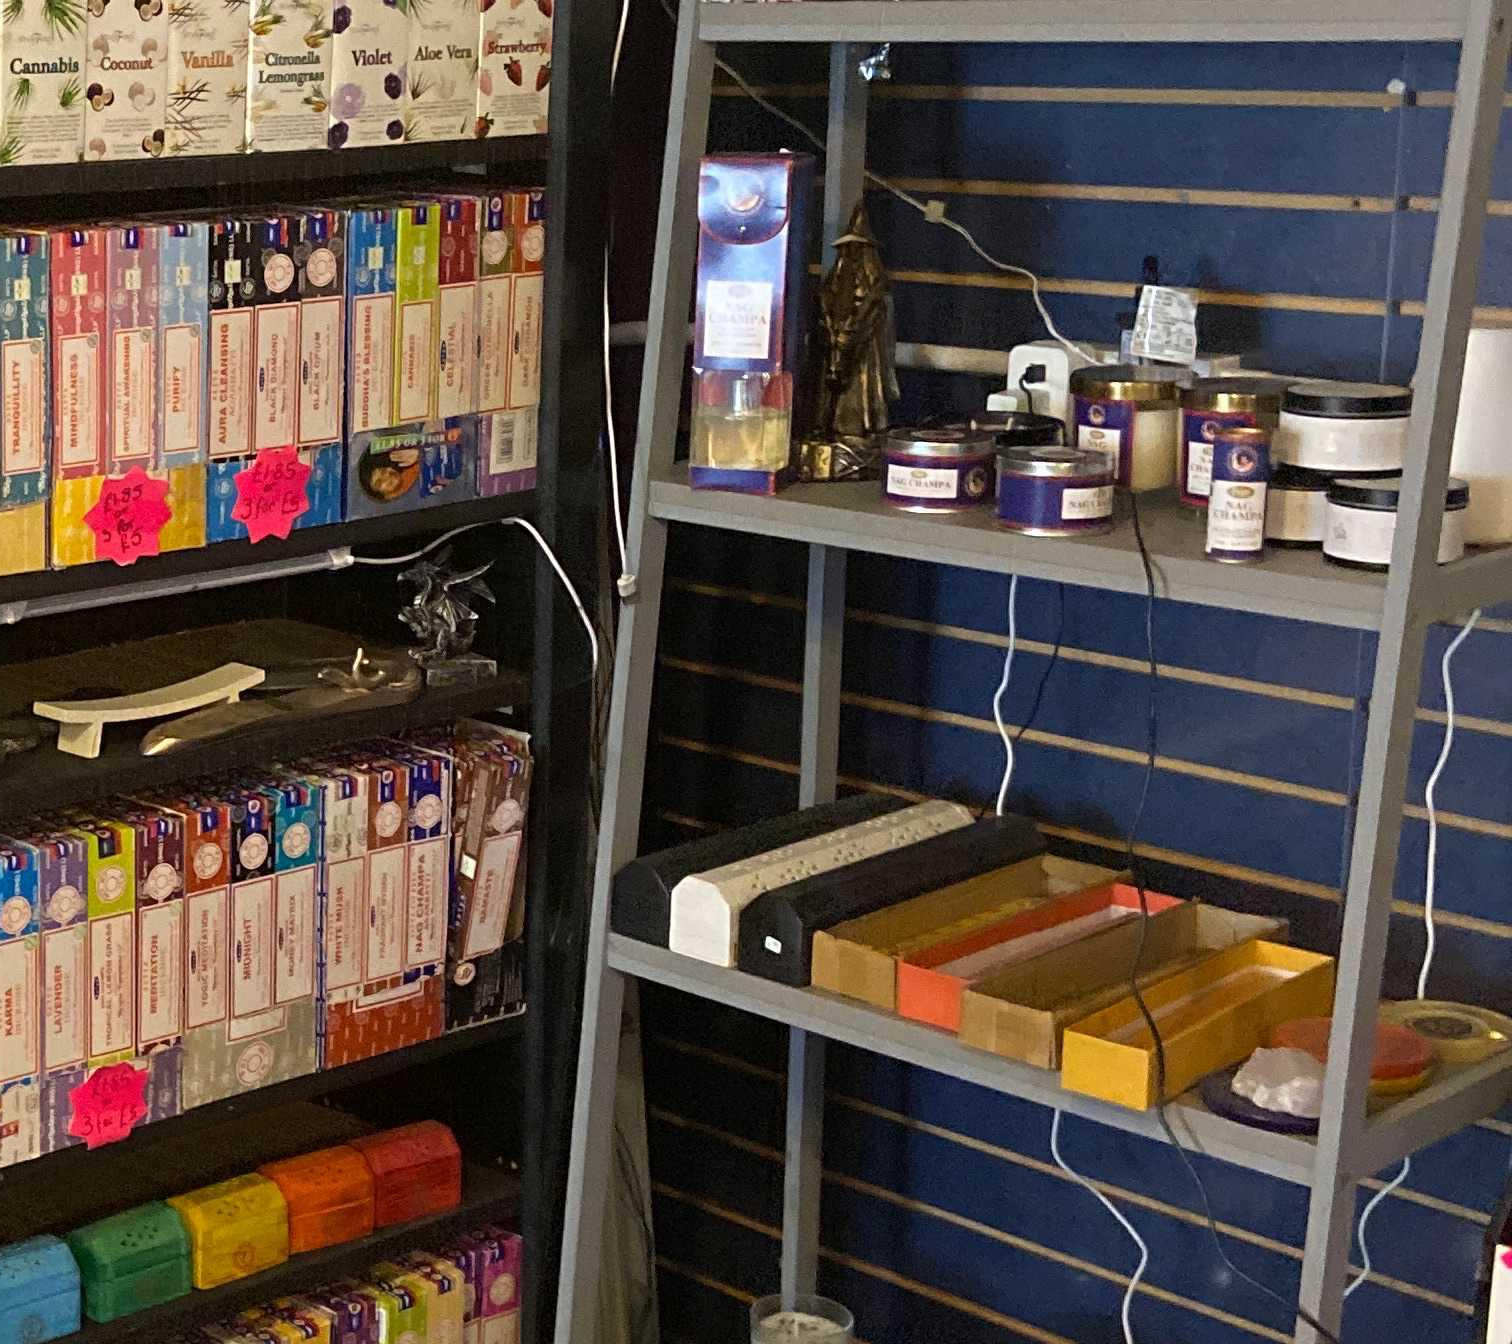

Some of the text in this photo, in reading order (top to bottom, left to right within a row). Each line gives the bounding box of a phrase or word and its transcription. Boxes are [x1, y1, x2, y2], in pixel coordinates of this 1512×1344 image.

[100, 55, 153, 72] Coconut
[182, 49, 234, 69] Vanilla
[265, 52, 321, 67] Citronella
[351, 49, 392, 67] Violet
[415, 45, 473, 61] Aloe Vera
[487, 40, 548, 56] Strawberry
[10, 57, 79, 75] Cannabis
[258, 70, 325, 86] Lemongrass
[220, 323, 229, 402] CLEANSING
[362, 304, 372, 428] BUDDHA'S BLESSING
[70, 354, 78, 448] MINDFULNESS
[172, 366, 180, 413] PURIFY
[269, 387, 277, 422] BLACK
[255, 498, 273, 518] for
[121, 530, 142, 553] £5
[416, 854, 425, 918] CHAMPA
[243, 918, 252, 980] MIDNIGHT
[335, 925, 343, 965] WHITE
[150, 934, 159, 1014] MEDITATION
[4, 987, 13, 1036] KARMA
[54, 965, 63, 1034] LAVENDER
